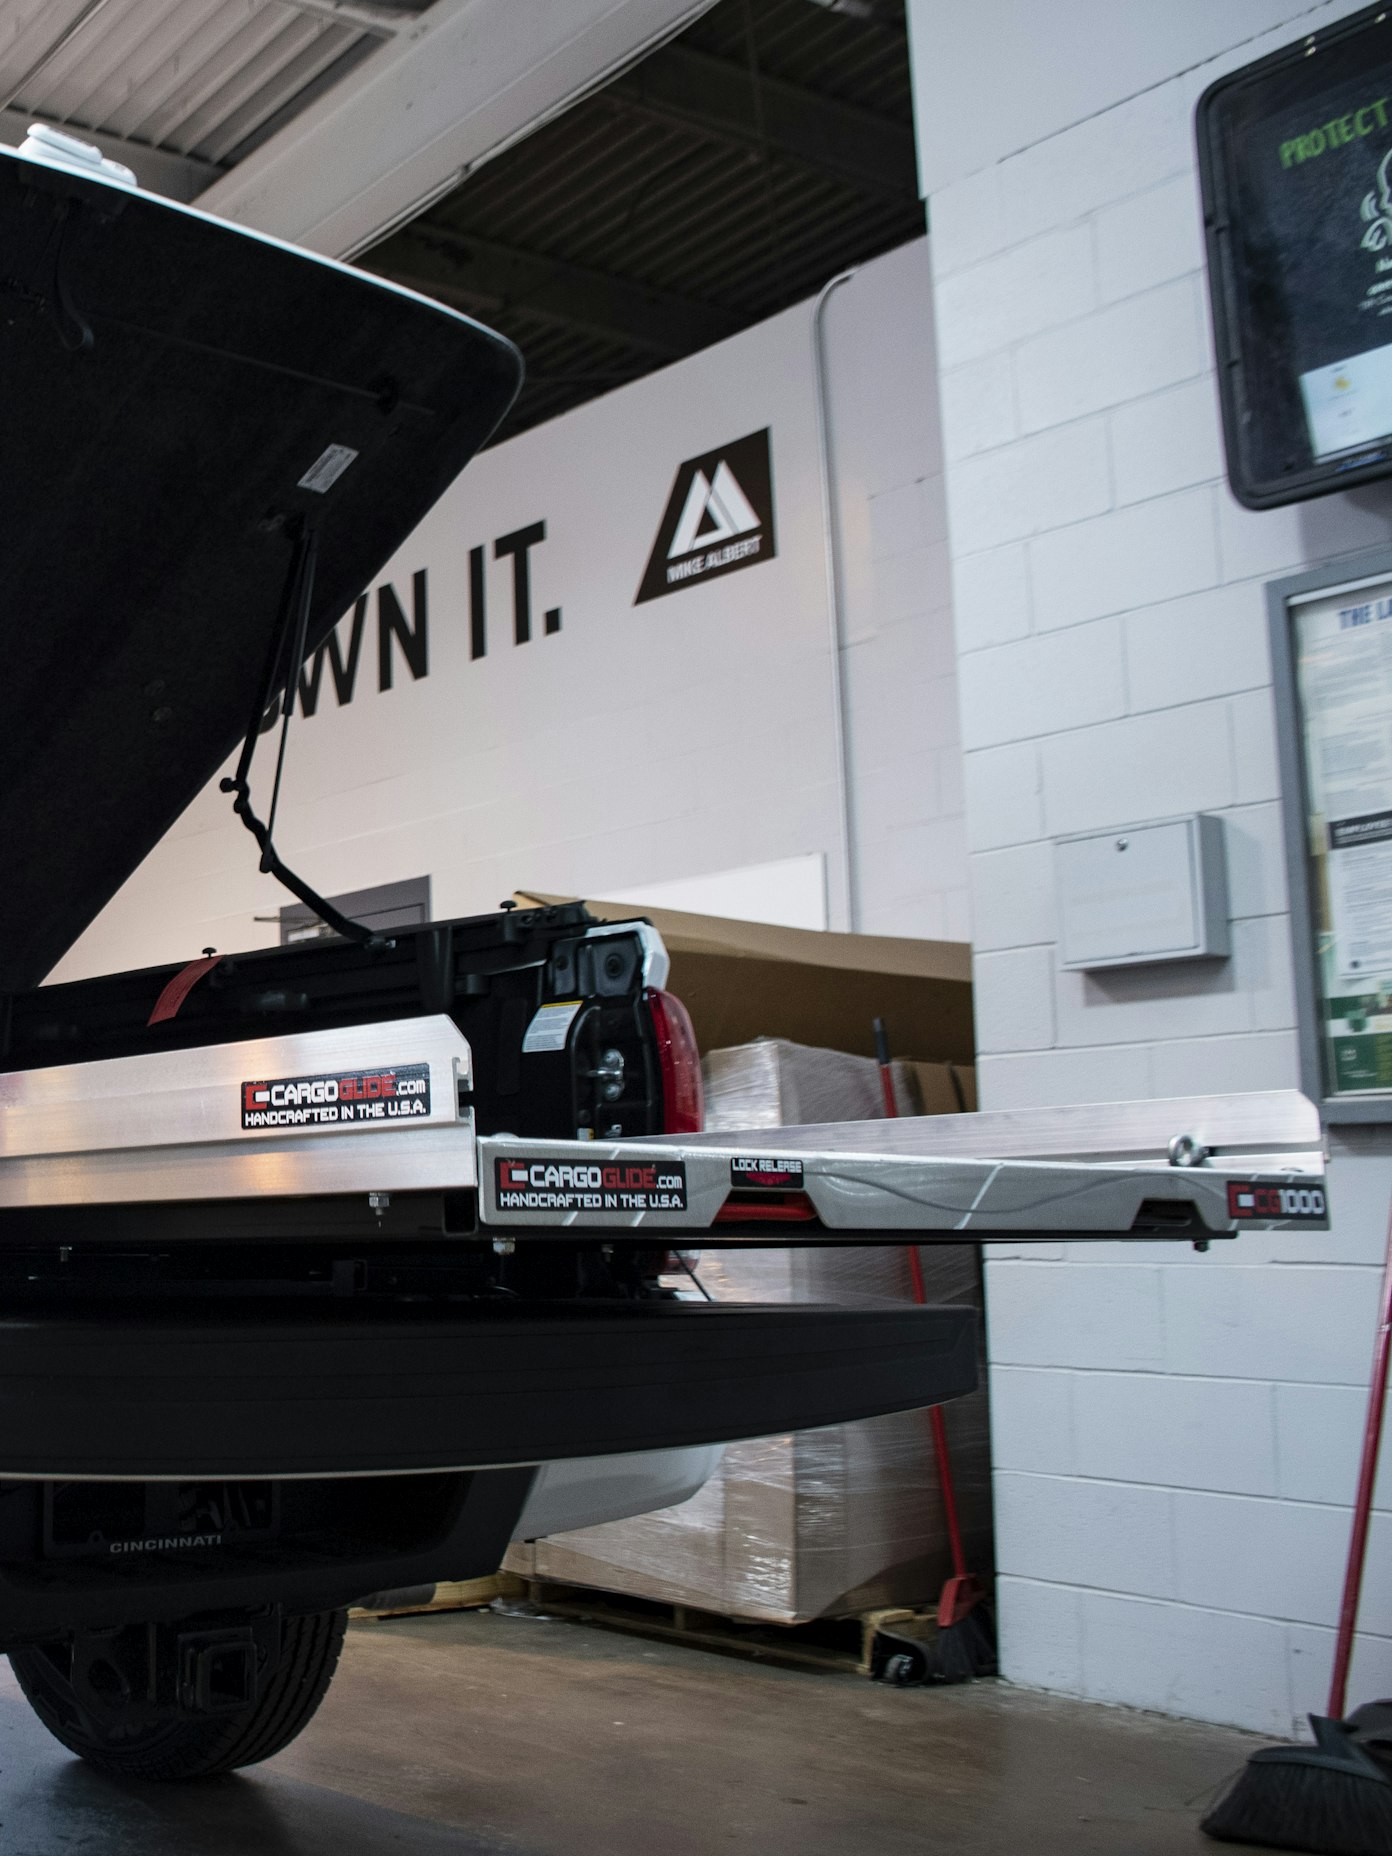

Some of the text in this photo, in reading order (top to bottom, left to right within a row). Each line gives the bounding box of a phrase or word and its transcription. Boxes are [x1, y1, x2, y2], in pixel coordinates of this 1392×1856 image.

[1280, 97, 1392, 169] PROTECT
[666, 533, 763, 585] MIKE ALBERT
[467, 518, 562, 662] IT.
[1339, 604, 1371, 631] THE
[244, 1098, 427, 1127] HANDCRAFTED IN THE U.S.A.
[732, 1158, 803, 1174] LOCK RELEASE
[500, 1192, 684, 1209] HANDCRAFTED IN THE U.S.A.
[109, 1534, 223, 1554] CINCINNATI
